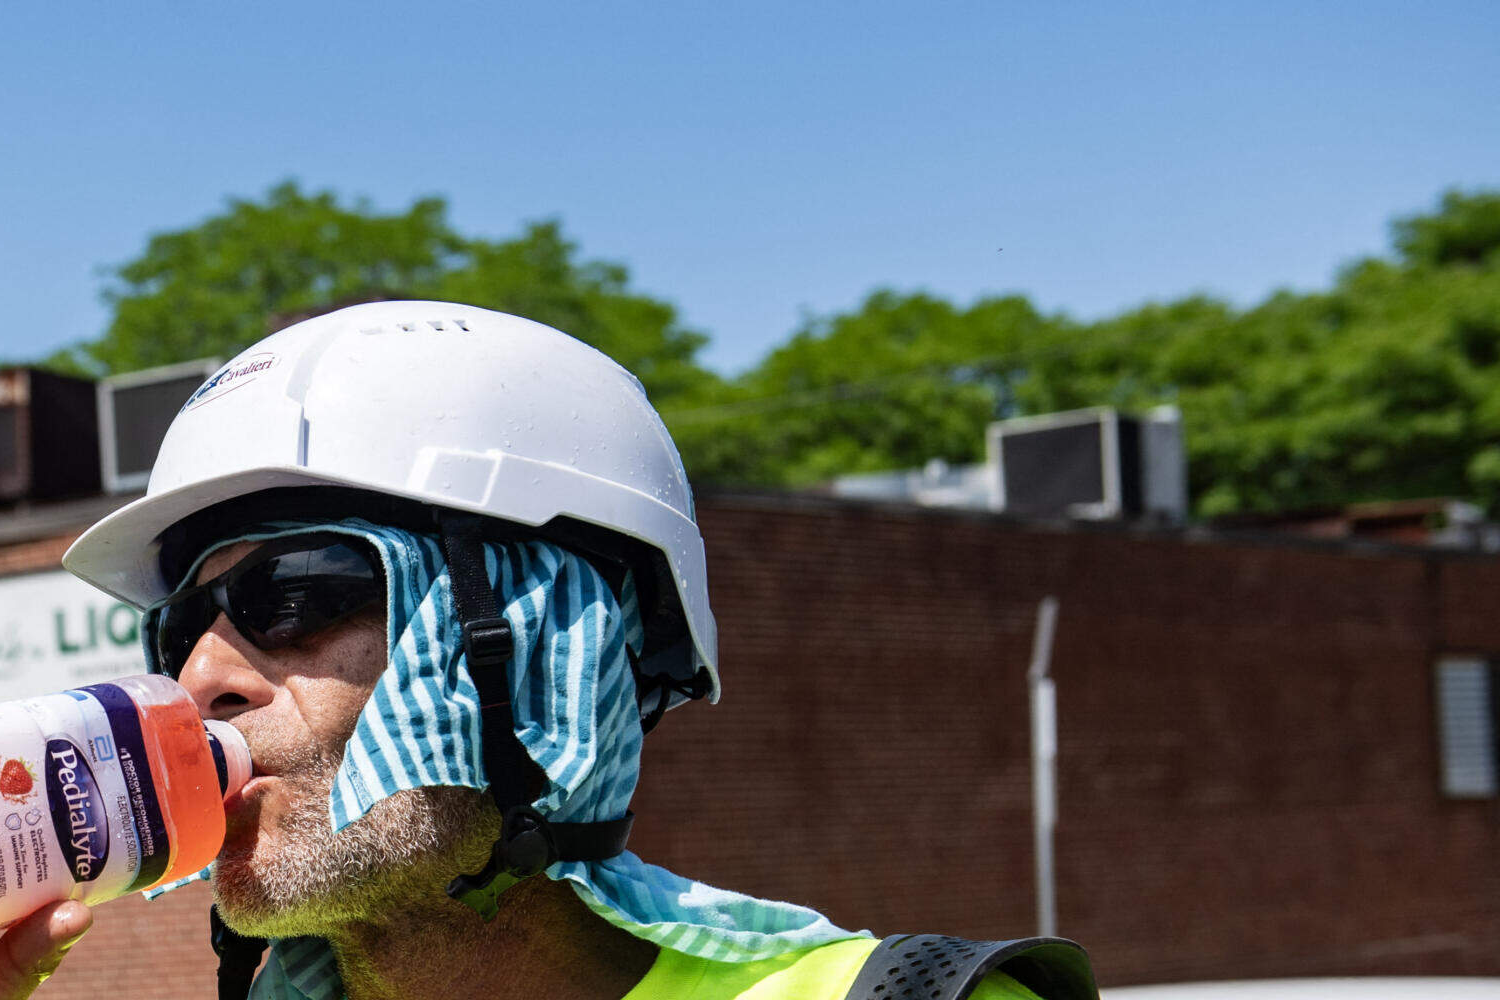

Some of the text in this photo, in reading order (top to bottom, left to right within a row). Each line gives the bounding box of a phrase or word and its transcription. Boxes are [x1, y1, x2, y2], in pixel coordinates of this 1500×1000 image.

[219, 356, 276, 385] Cavalieri
[50, 745, 98, 877] Pedialyte
[116, 794, 140, 873] ELECTROLYTE SOLUTION
[126, 759, 141, 794] DOCTOR
[138, 794, 154, 857] RECOMMENDED
[10, 834, 24, 890] IMMUNE SUPPORT
[29, 829, 44, 884] ELECTROLYTES
